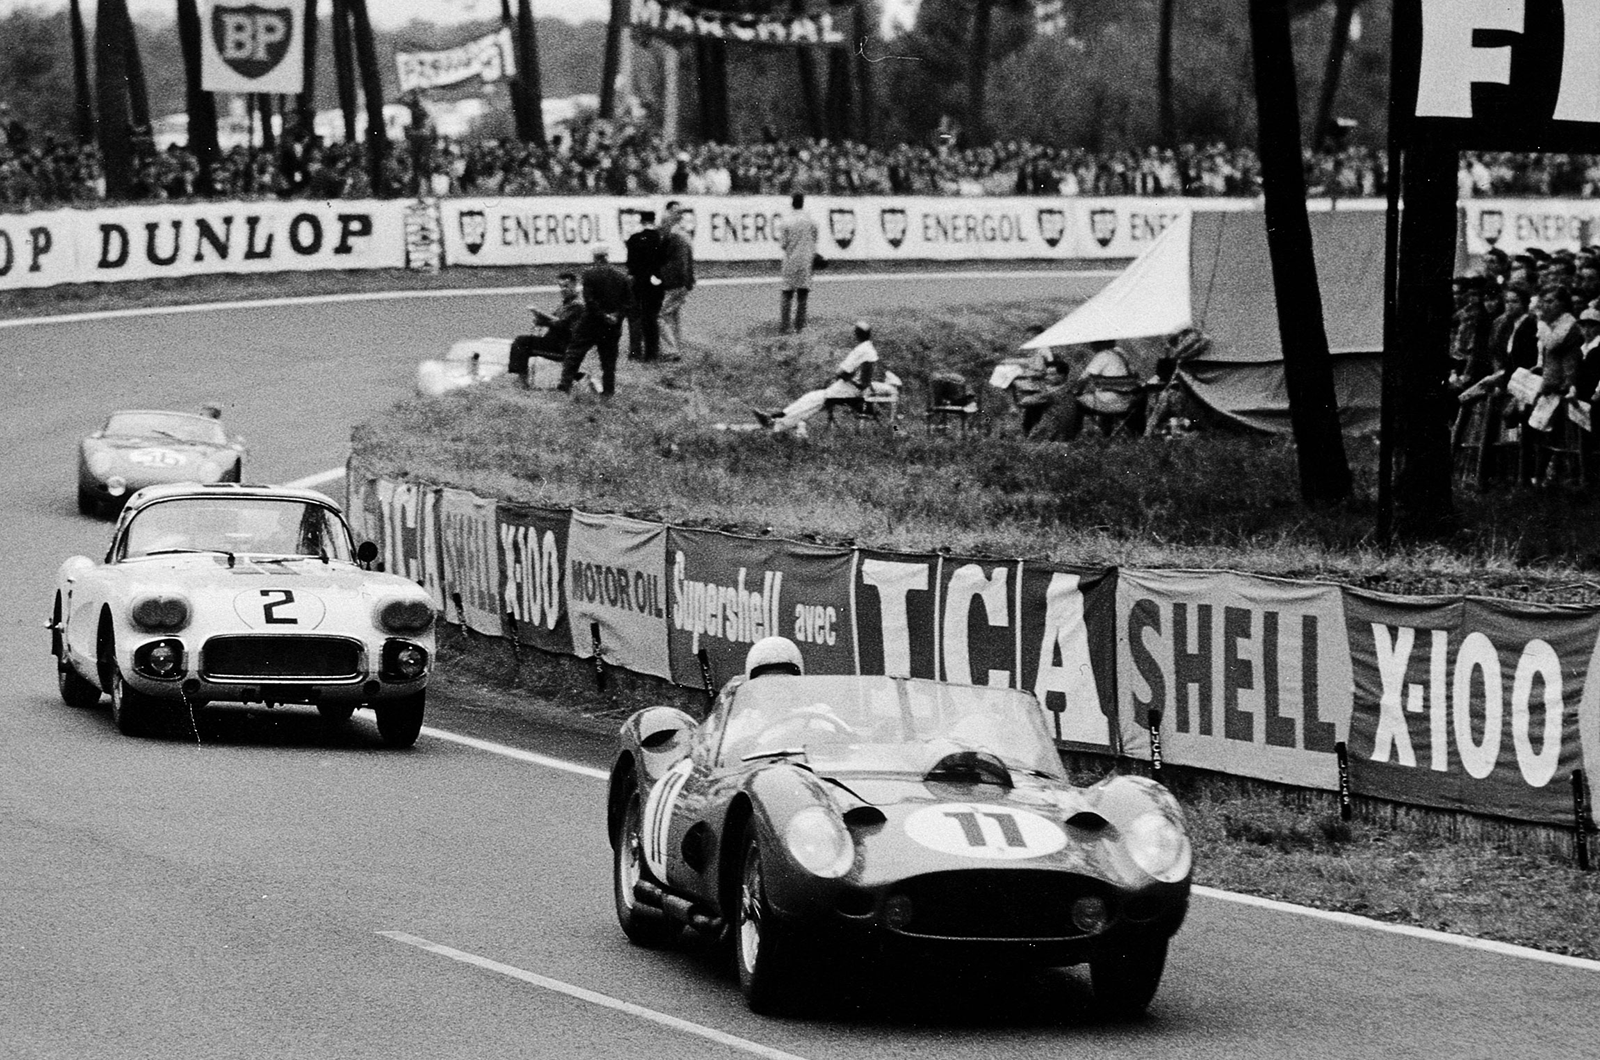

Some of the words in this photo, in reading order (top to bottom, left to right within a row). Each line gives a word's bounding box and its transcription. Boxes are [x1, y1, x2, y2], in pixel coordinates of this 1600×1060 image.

[222, 13, 287, 61] BP
[1415, 0, 1600, 122] F
[98, 213, 373, 269] DUNLOP
[501, 214, 606, 246] ENERGOL
[923, 213, 1027, 242] ENERGOL
[501, 522, 560, 631] X-100
[572, 560, 632, 611] MOTOR
[634, 570, 663, 619] OIL
[673, 551, 783, 655] Supershell
[794, 603, 837, 646] avec
[260, 590, 298, 624] 2
[1128, 598, 1337, 754] SHELL
[1371, 622, 1564, 788] X-100
[1151, 726, 1161, 770] LUCAS
[943, 811, 1028, 848] 11
